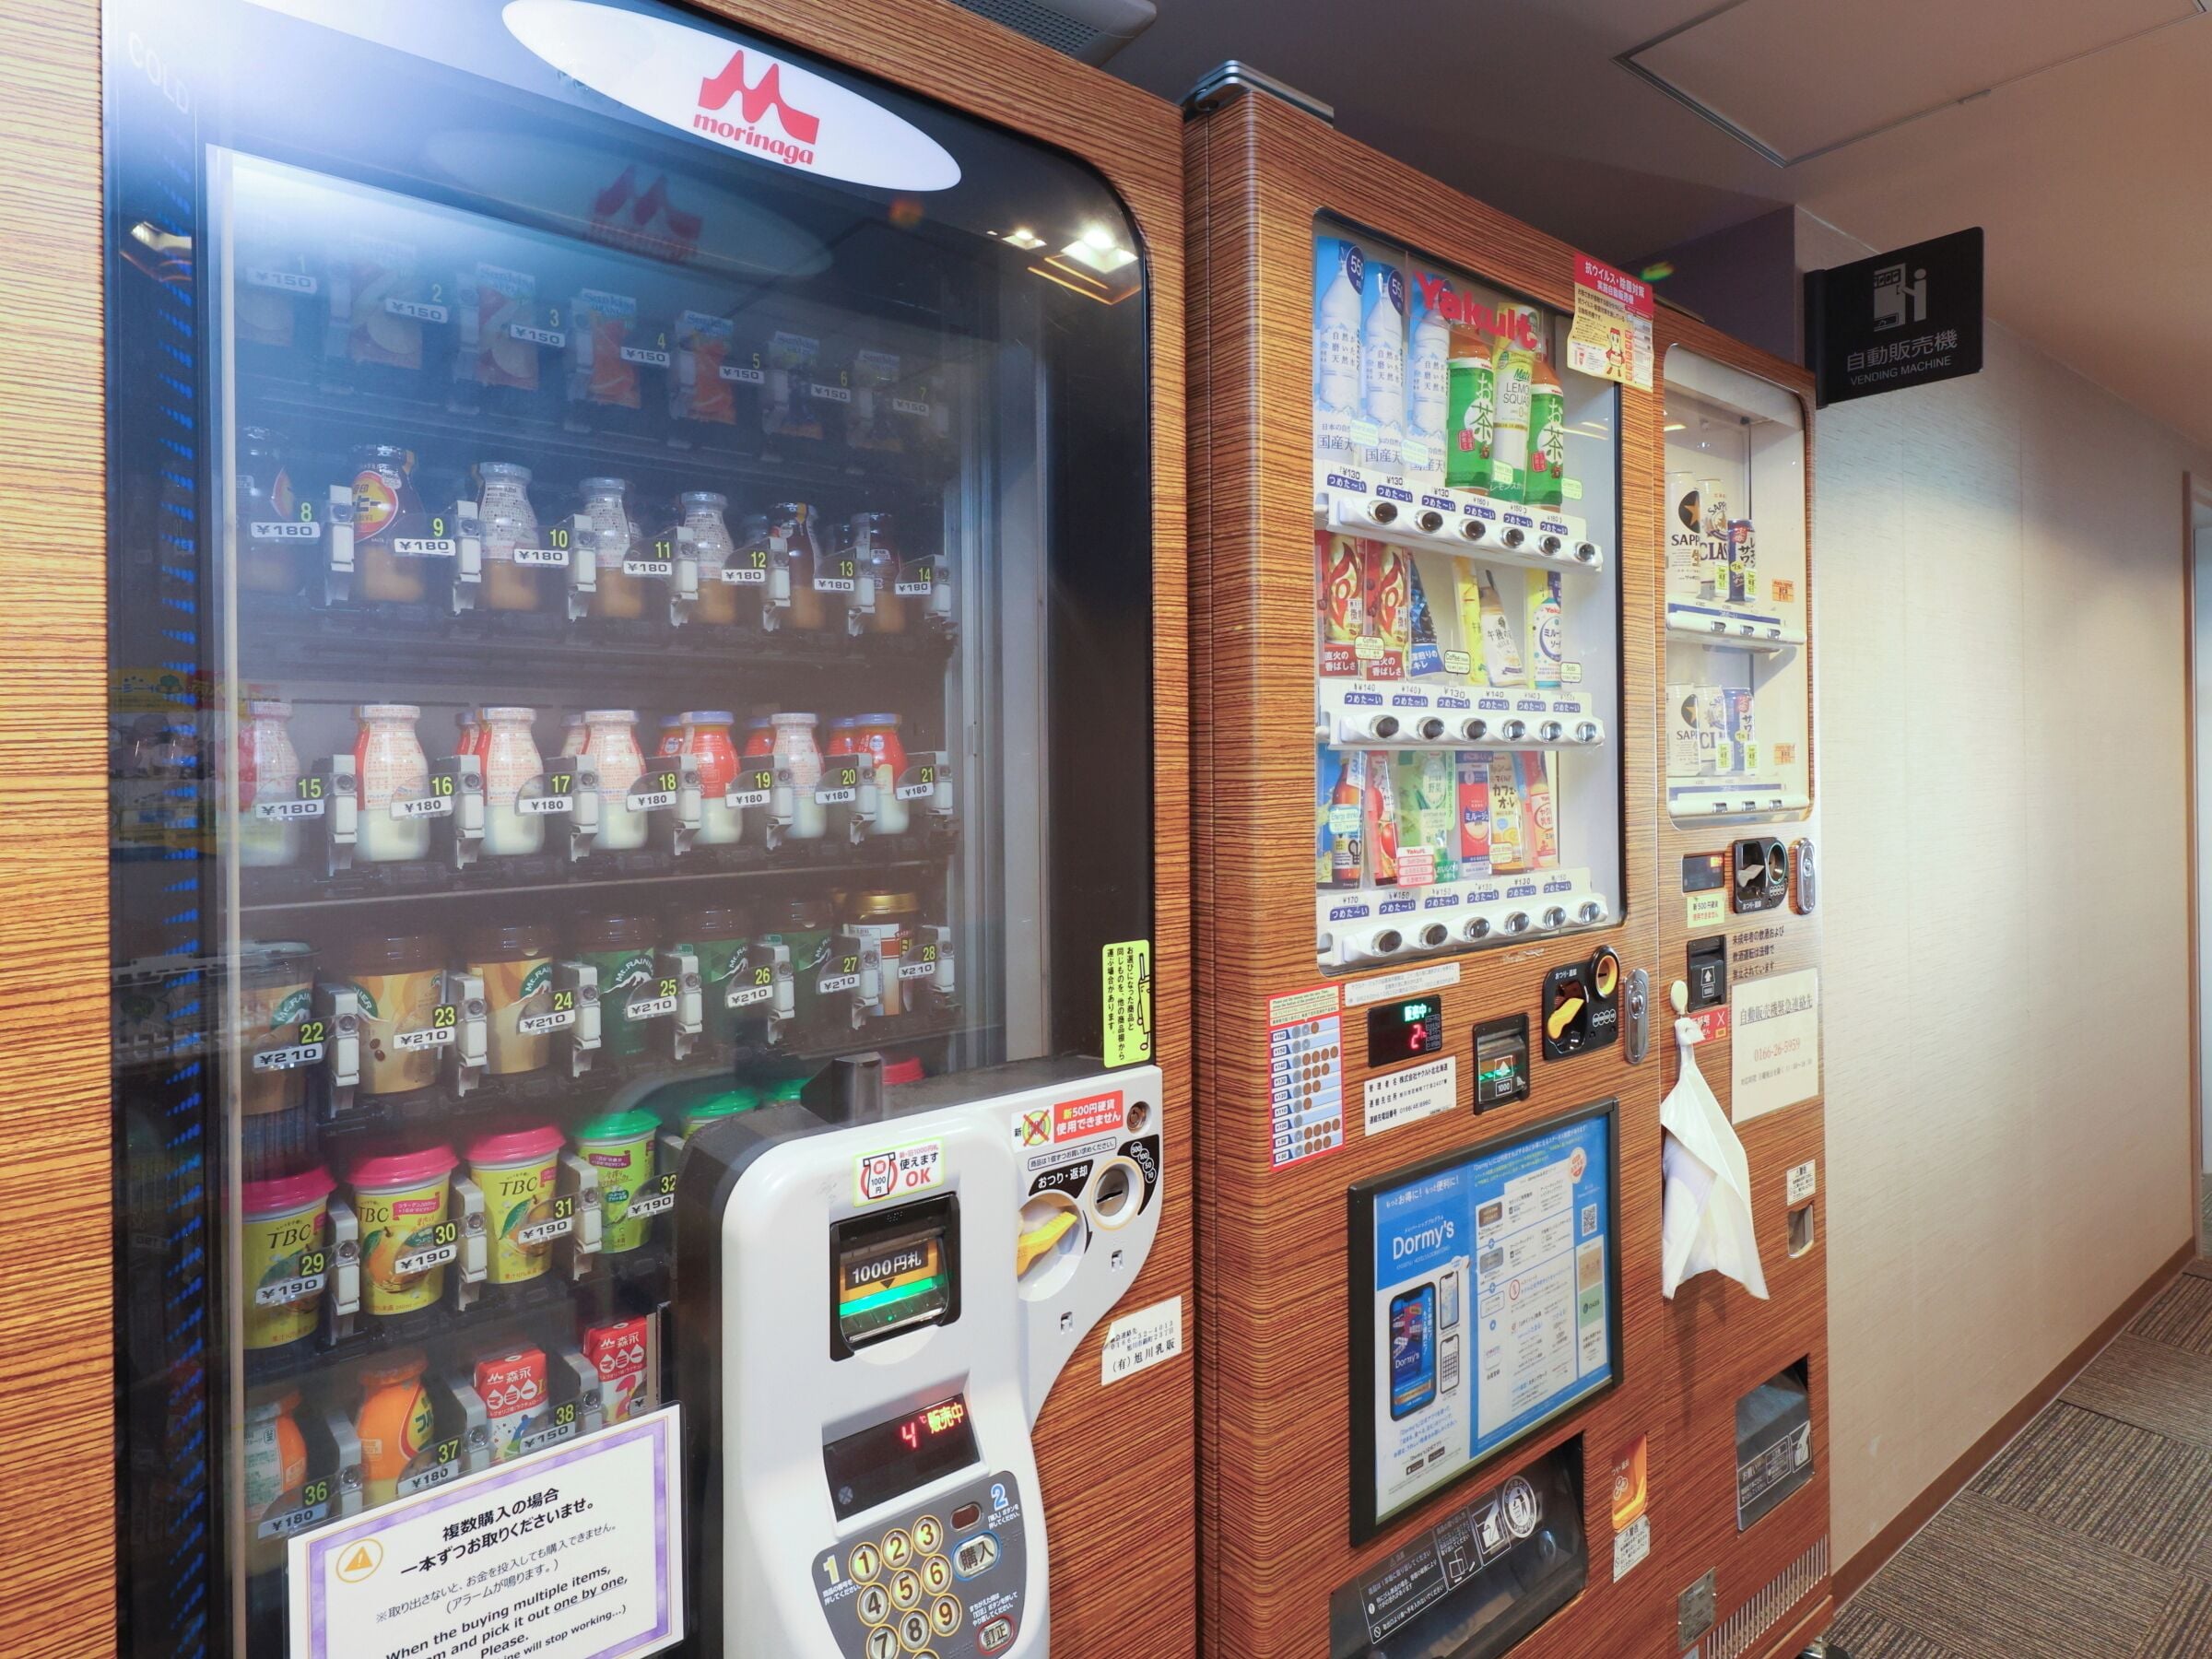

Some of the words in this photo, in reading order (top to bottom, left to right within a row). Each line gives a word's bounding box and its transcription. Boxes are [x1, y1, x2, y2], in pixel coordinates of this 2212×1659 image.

[128, 31, 190, 116] COLD
[693, 112, 815, 166] morinaga
[1413, 270, 1538, 351] Yakult
[657, 333, 665, 349] 4
[1847, 328, 1959, 373] 自動販売機
[752, 352, 760, 369] 5
[840, 371, 848, 387] 6
[1850, 367, 1899, 387] VENDING
[1900, 355, 1953, 375] MACHINE
[1469, 372, 1493, 440] お茶
[1542, 397, 1564, 461] お茶
[1343, 467, 1360, 480] ¥130
[300, 502, 312, 522] 8
[257, 524, 313, 537] ¥180
[432, 518, 443, 536] 9
[399, 540, 450, 553] ¥180
[550, 529, 568, 548] 10
[519, 550, 563, 562] ¥180
[655, 542, 671, 559] 11
[751, 551, 766, 569] 12
[628, 561, 668, 573] ¥180
[725, 570, 762, 581] ¥180
[840, 560, 853, 577] 13
[918, 567, 931, 583] 14
[818, 579, 852, 591] ¥180
[898, 581, 929, 594] ¥180
[552, 774, 571, 794] 17
[659, 772, 677, 792] 18
[755, 771, 771, 788] 19
[842, 768, 856, 785] 20
[922, 767, 934, 783] 21
[299, 778, 322, 799] 15
[432, 776, 453, 796] 16
[825, 789, 850, 802] ¥180
[904, 783, 928, 798] ¥180
[405, 798, 443, 813] ¥180
[531, 798, 564, 811] ¥180
[638, 794, 667, 806] ¥180
[736, 793, 763, 805] ¥180
[261, 802, 318, 817] ¥180
[923, 946, 935, 961] 28
[843, 957, 857, 973] 27
[900, 964, 933, 976] ¥210
[755, 968, 771, 984] 26
[824, 977, 855, 991] ¥210
[660, 979, 677, 997] 25
[731, 988, 769, 1005] ¥210
[554, 991, 573, 1010] 24
[631, 999, 673, 1015] ¥210
[435, 1006, 455, 1028] 23
[524, 1013, 567, 1030] ¥210
[300, 1021, 324, 1044] 22
[399, 1029, 449, 1045] ¥210
[1411, 1024, 1422, 1049] 2
[259, 1048, 317, 1065] ¥210
[1498, 1082, 1511, 1093] 1000
[1062, 1099, 1115, 1121] 新500円硬貨
[1014, 1127, 1022, 1136] 新
[1056, 1110, 1122, 1136] 使用できません
[900, 1152, 939, 1171] 使えます
[1139, 1151, 1149, 1160] 100
[1144, 1161, 1152, 1170] 50
[498, 1176, 539, 1197] TBC
[661, 1174, 677, 1194] 32
[871, 1175, 887, 1186] 1000
[905, 1167, 932, 1187] OK
[1037, 1164, 1089, 1190] おつり・返却
[358, 1206, 390, 1224] TBC
[555, 1197, 572, 1219] 31
[631, 1195, 672, 1215] ¥190
[266, 1223, 312, 1249] TBC
[435, 1222, 456, 1245] 30
[523, 1219, 568, 1241] ¥190
[1392, 1219, 1454, 1260] Dormy's
[301, 1253, 324, 1277] 29
[400, 1248, 451, 1270] ¥190
[852, 1250, 922, 1284] 1000円札
[262, 1278, 319, 1300] ¥190
[617, 1332, 640, 1348] 森永
[506, 1366, 532, 1383] 森永
[556, 1403, 574, 1426] 38
[927, 1402, 965, 1434] 販売中
[524, 1425, 570, 1448] ¥150
[901, 1422, 917, 1448] 4
[438, 1440, 459, 1464] 37
[412, 1467, 449, 1488] ¥180
[304, 1481, 328, 1505] 36
[991, 1483, 1008, 1512] 2
[272, 1509, 314, 1532] ¥180
[443, 1487, 560, 1543] 複数購入の場合
[401, 1498, 594, 1575] 一本ずつお取りくださいませ。
[920, 1523, 935, 1546] 3
[889, 1536, 904, 1560] 2
[959, 1541, 994, 1571] 購入
[823, 1554, 841, 1585] 1
[859, 1550, 870, 1574] 1
[929, 1561, 945, 1585] 6
[899, 1576, 913, 1601] 5
[386, 1640, 429, 1659] When
[433, 1628, 457, 1646] the
[462, 1606, 510, 1634] buying
[513, 1580, 569, 1612] multiple
[571, 1566, 612, 1587] items,
[867, 1592, 882, 1615] 4
[939, 1601, 953, 1625] 9
[451, 1635, 478, 1653] and
[482, 1622, 511, 1648] pick
[513, 1616, 524, 1630] it
[527, 1606, 551, 1622] out
[554, 1596, 579, 1614] one
[582, 1586, 598, 1606] by
[600, 1576, 629, 1594] one,
[908, 1618, 923, 1643] 8
[983, 1622, 1008, 1647] 訂正
[480, 1632, 530, 1659] Please.
[523, 1640, 543, 1656] will
[545, 1630, 569, 1649] stop
[875, 1632, 888, 1659] 7
